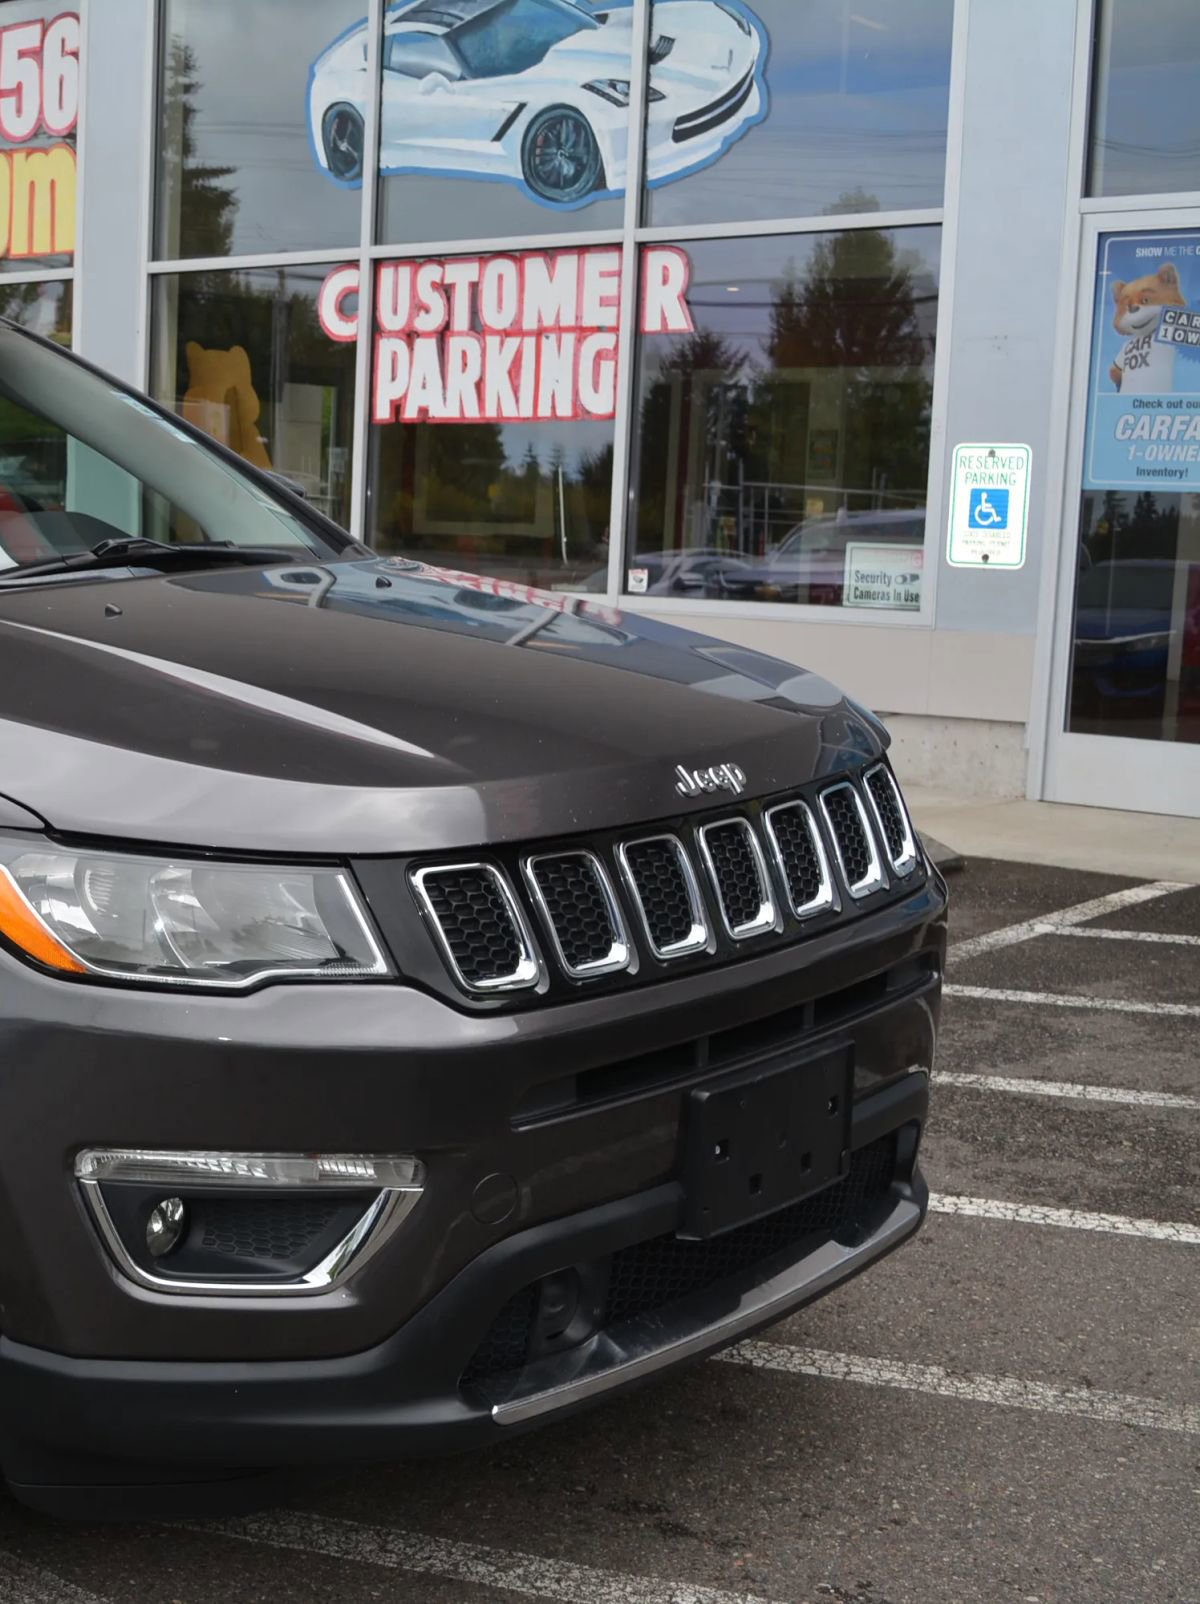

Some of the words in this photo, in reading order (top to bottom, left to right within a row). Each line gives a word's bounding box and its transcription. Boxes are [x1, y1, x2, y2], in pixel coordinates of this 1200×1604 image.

[1135, 247, 1162, 257] SHOW
[1163, 246, 1177, 256] ME
[1178, 245, 1194, 256] THE
[318, 244, 694, 342] CUSTOMER
[1165, 311, 1200, 327] CAR
[1125, 335, 1152, 355] CAR
[1174, 330, 1200, 344] OW
[1124, 351, 1150, 370] FOX
[372, 330, 619, 424] PARKING
[1132, 398, 1163, 409] Check
[1166, 399, 1183, 409] out
[1186, 401, 1200, 409] ou
[1114, 413, 1200, 441] CARFA
[1128, 444, 1200, 462] 1-OWNE
[959, 455, 1024, 470] RESERVED
[964, 471, 1017, 487] PARKING
[1136, 466, 1189, 479] Inventory!
[855, 570, 892, 587] Security
[853, 585, 890, 601] Cameras
[904, 587, 920, 602] Use
[675, 763, 746, 798] Jeep
